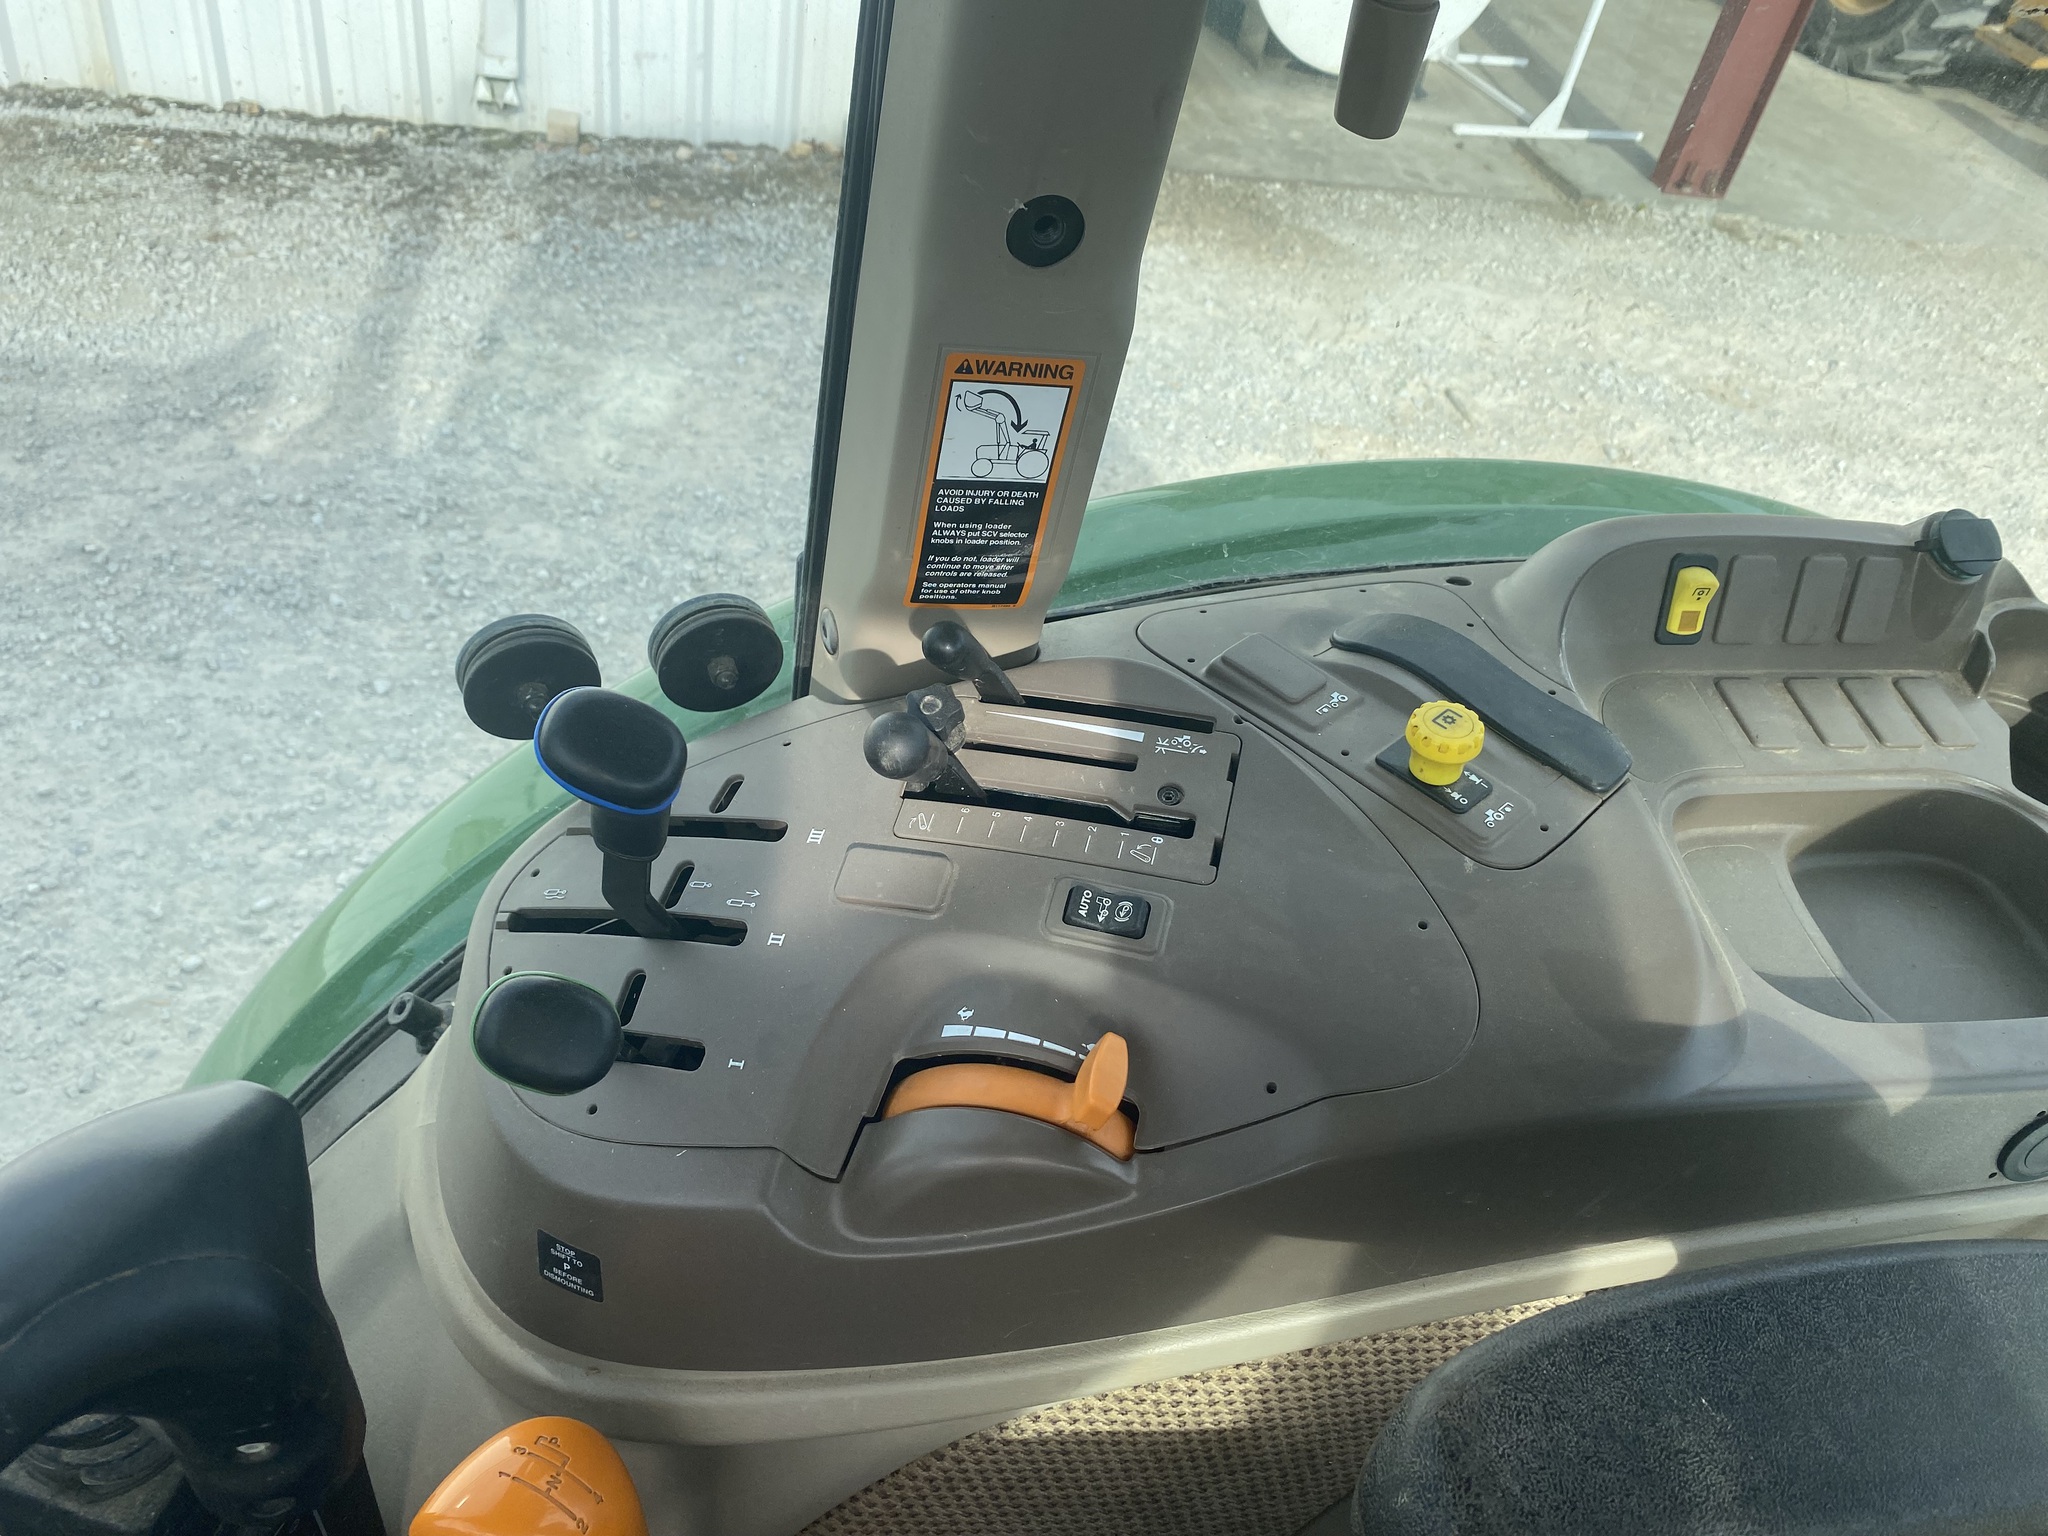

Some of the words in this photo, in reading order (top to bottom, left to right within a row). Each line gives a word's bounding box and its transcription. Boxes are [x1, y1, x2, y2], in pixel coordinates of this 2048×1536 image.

[975, 359, 1074, 380] WARNING
[933, 521, 957, 529] When
[959, 522, 983, 530] using
[989, 538, 1021, 546] position.
[979, 555, 1004, 563] loader
[1087, 825, 1098, 833] 2
[1078, 889, 1093, 917] AUTO
[556, 1243, 576, 1256] STOP
[550, 1248, 571, 1262] SHIFT
[572, 1258, 583, 1268] TO
[563, 1262, 571, 1271] P
[553, 1267, 583, 1285] BEFORE
[543, 1269, 595, 1297] DISMOUNTING
[548, 1436, 560, 1448] P
[513, 1446, 527, 1455] 3
[546, 1474, 562, 1490] N
[592, 1491, 604, 1505] 4
[576, 1517, 589, 1535] 2
